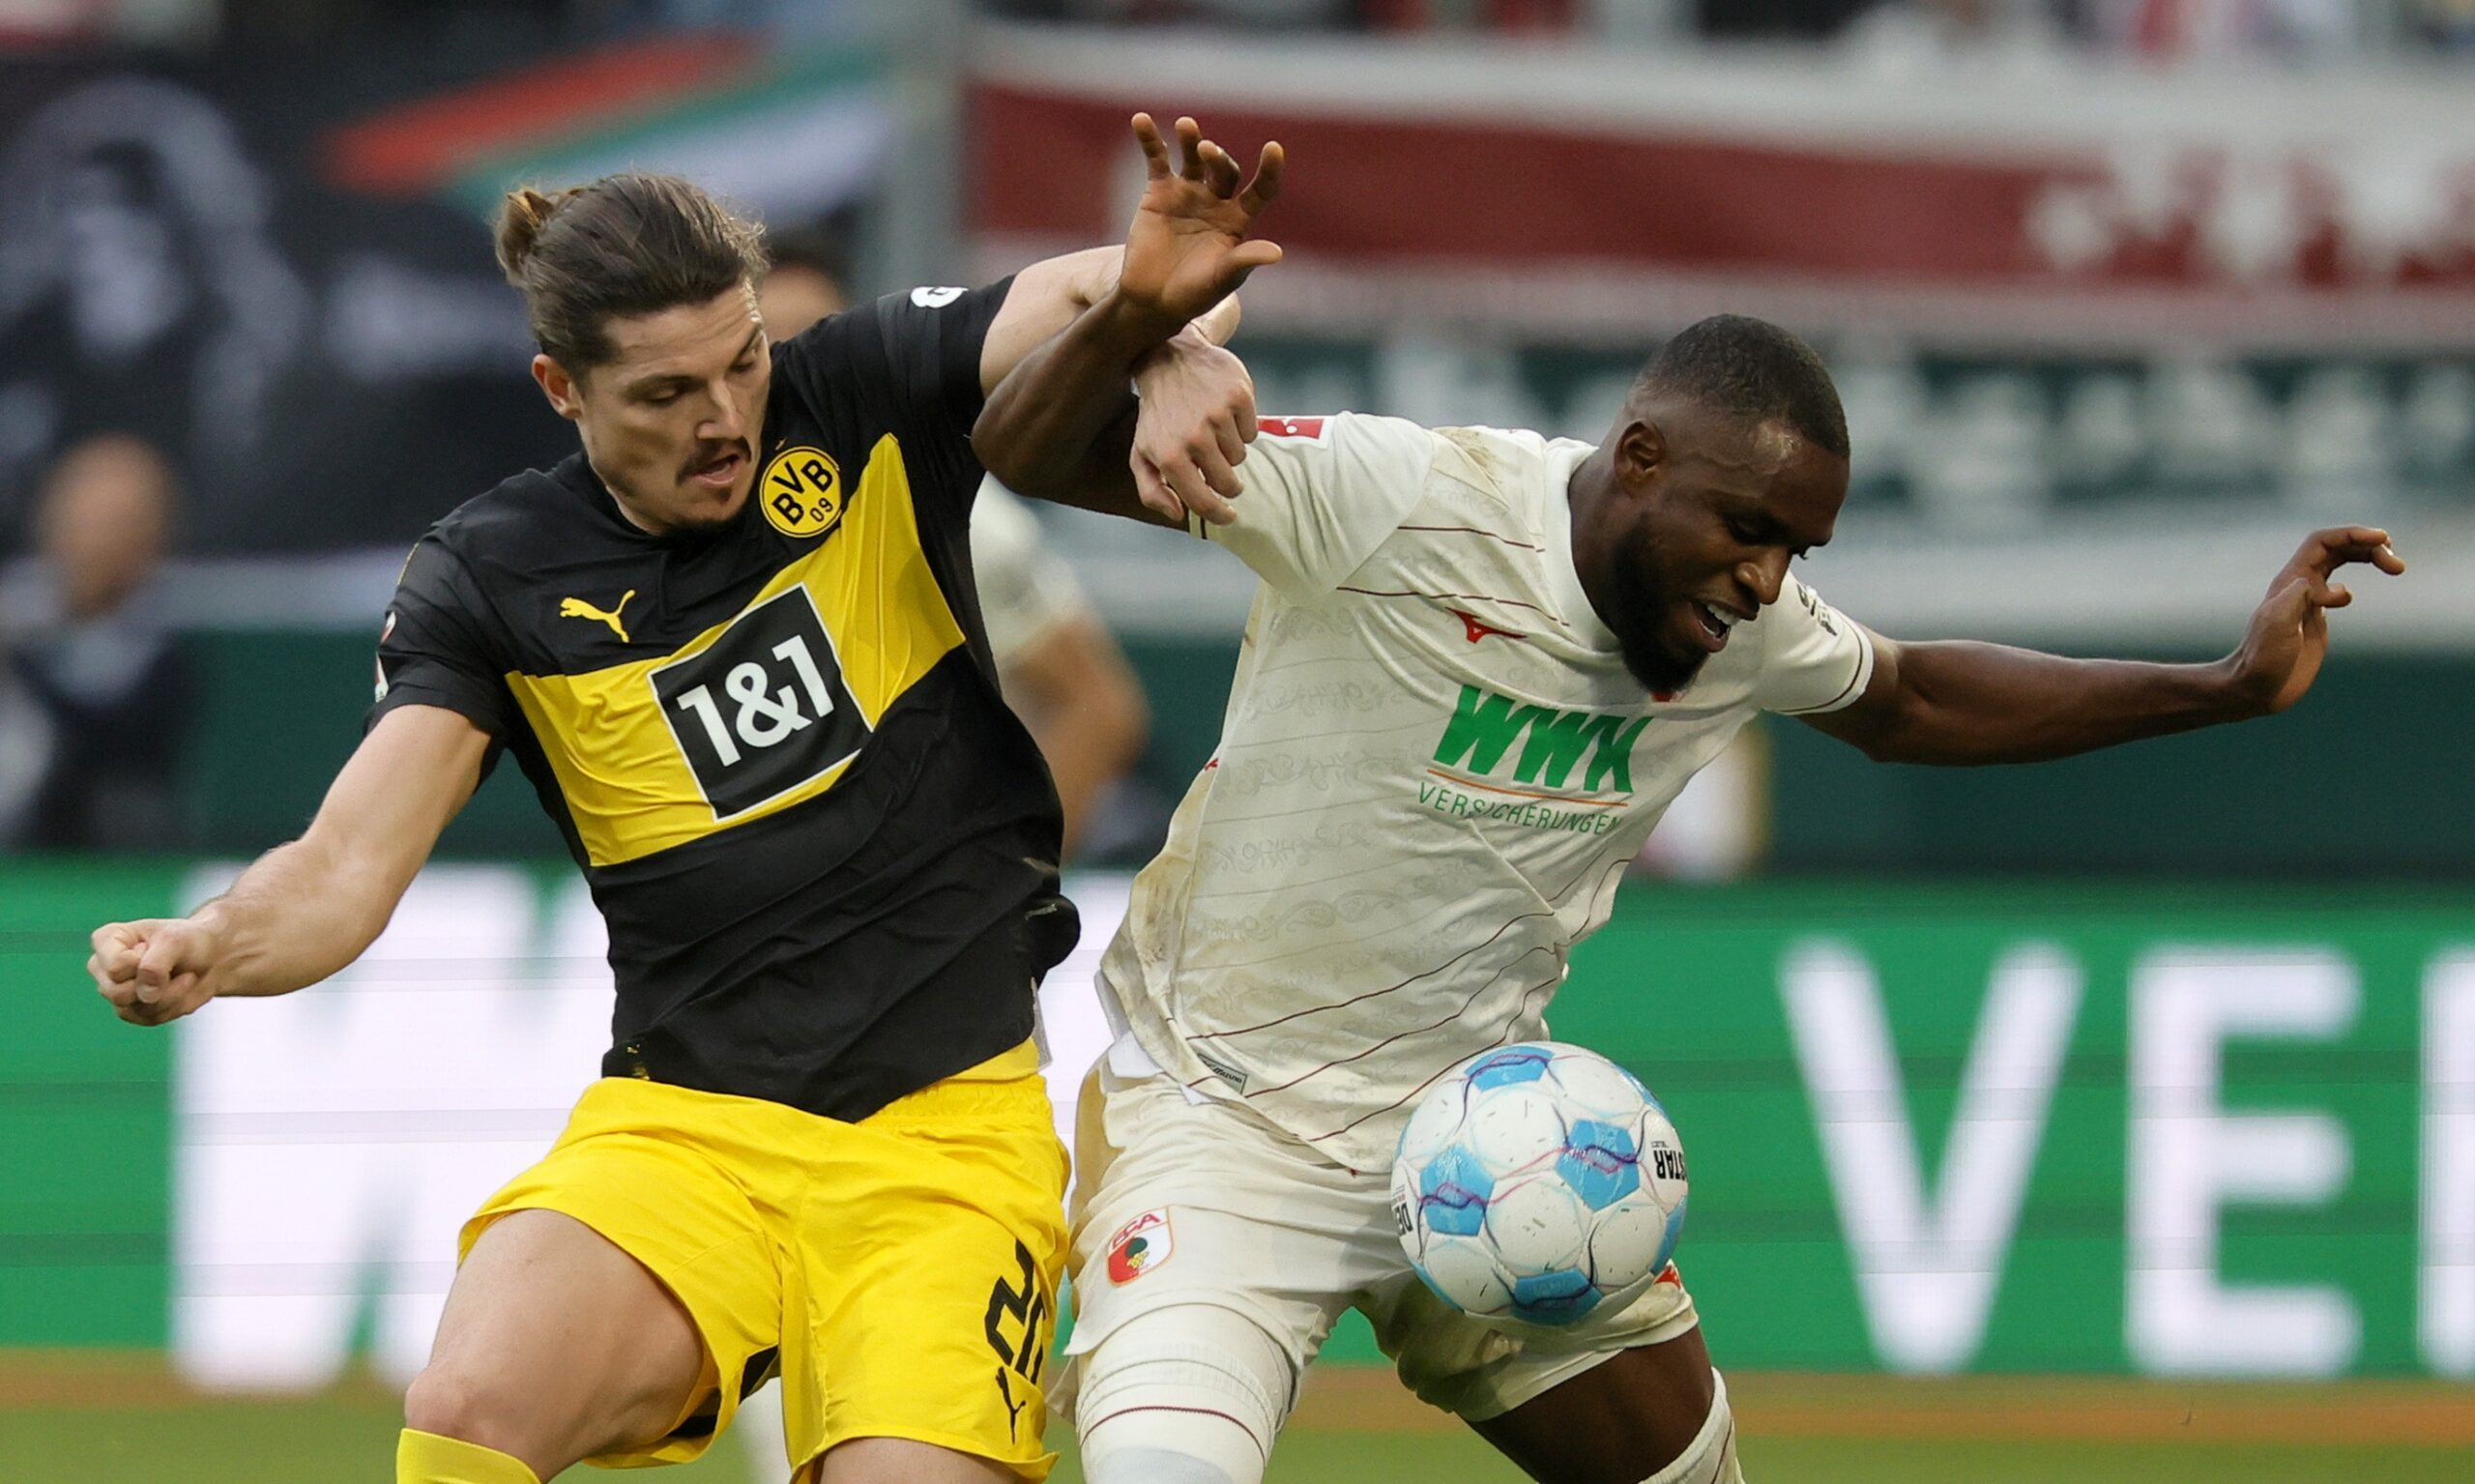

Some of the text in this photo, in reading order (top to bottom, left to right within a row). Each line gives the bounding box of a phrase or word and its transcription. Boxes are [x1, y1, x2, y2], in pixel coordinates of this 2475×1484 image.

[772, 459, 833, 526] BVB
[810, 497, 833, 522] 09
[677, 634, 834, 767] 1&1
[1433, 684, 1655, 794] WWK
[1418, 781, 1626, 836] VERSICHERUNGEN
[1111, 1212, 1161, 1250] FCA
